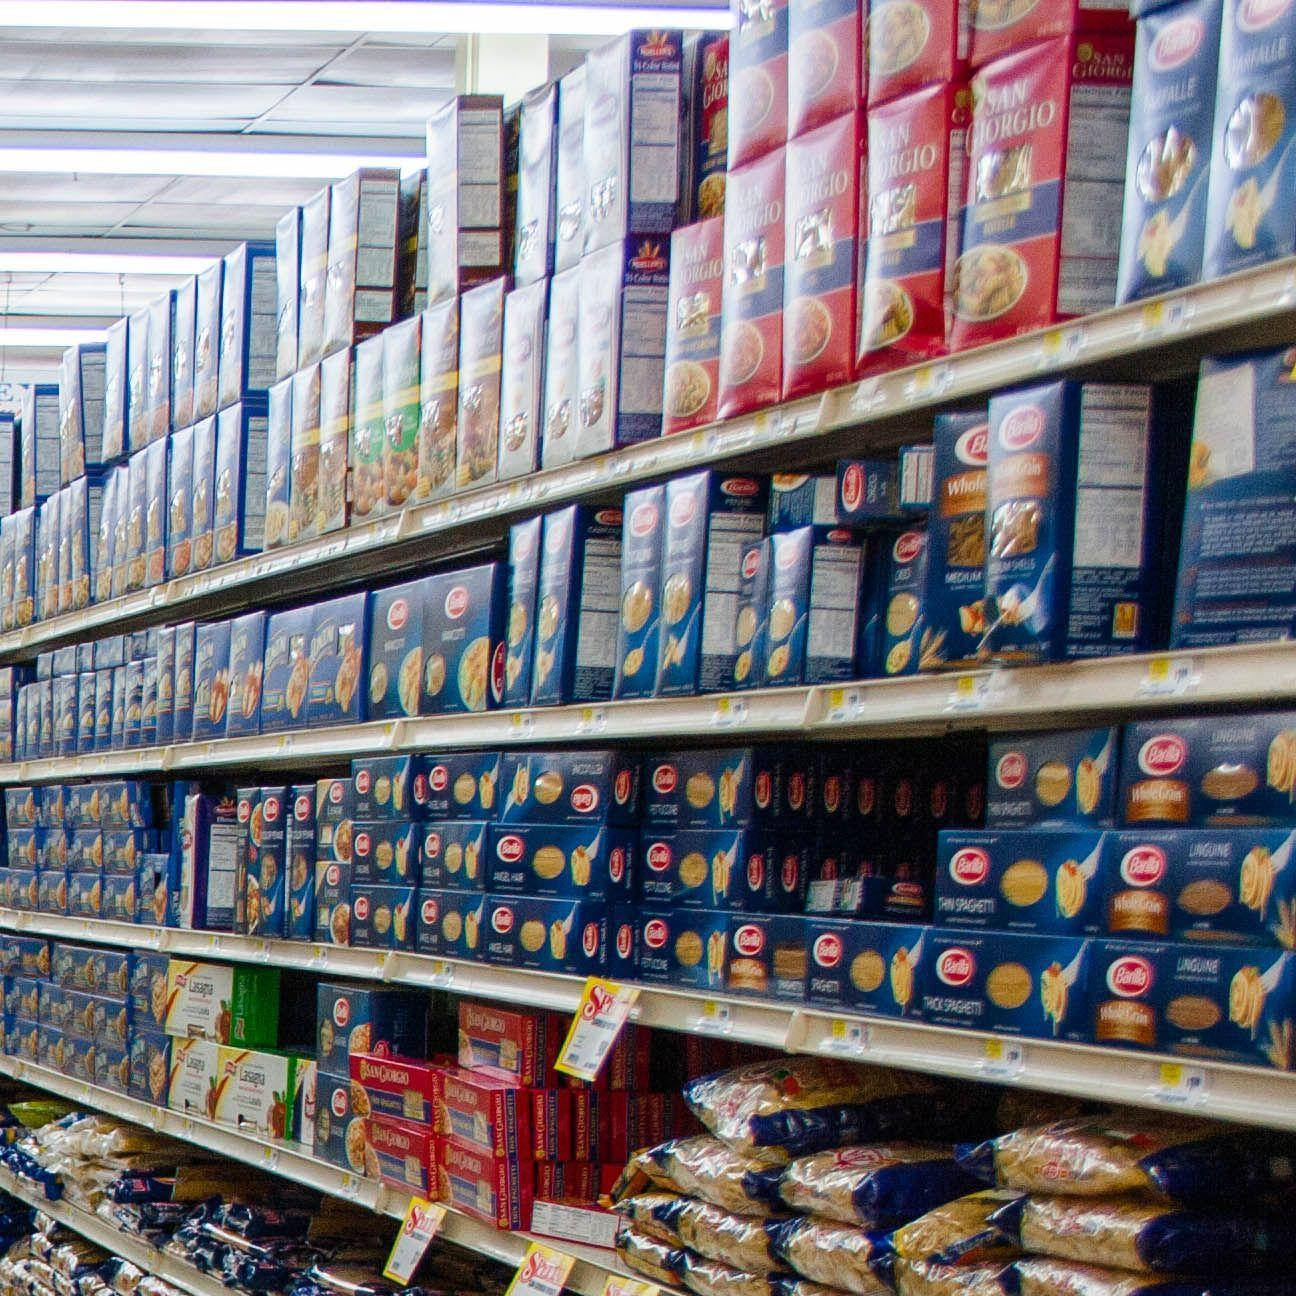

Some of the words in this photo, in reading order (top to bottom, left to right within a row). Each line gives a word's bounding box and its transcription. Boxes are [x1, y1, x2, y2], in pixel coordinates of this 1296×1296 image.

[989, 80, 1027, 108] SAN
[1145, 745, 1182, 766] Barilla
[1113, 966, 1146, 990] Barilla
